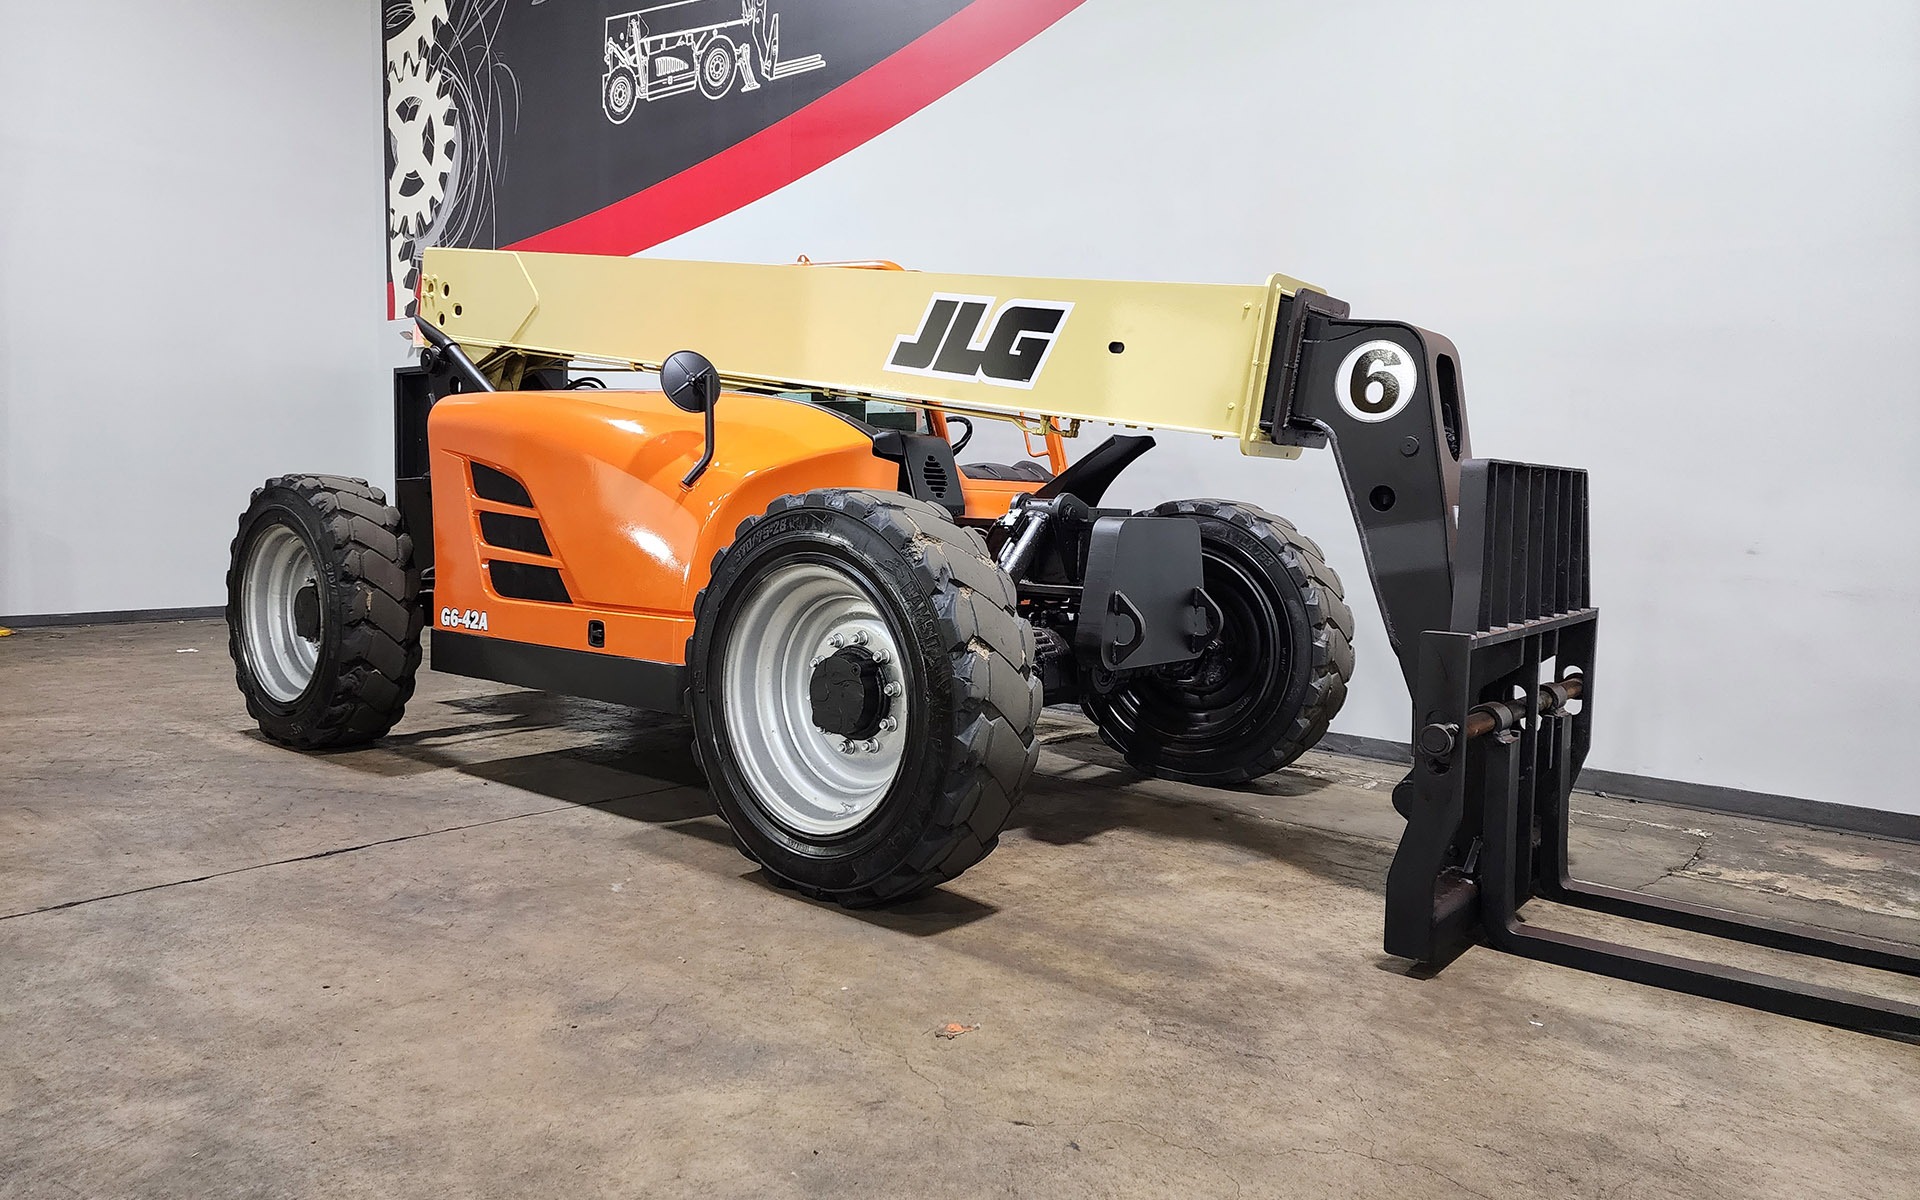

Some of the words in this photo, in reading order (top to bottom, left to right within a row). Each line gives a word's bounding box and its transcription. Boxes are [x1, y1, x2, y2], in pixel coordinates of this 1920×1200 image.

[888, 298, 1067, 384] JLG
[1349, 348, 1402, 414] 6
[440, 606, 489, 631] G6-42A
